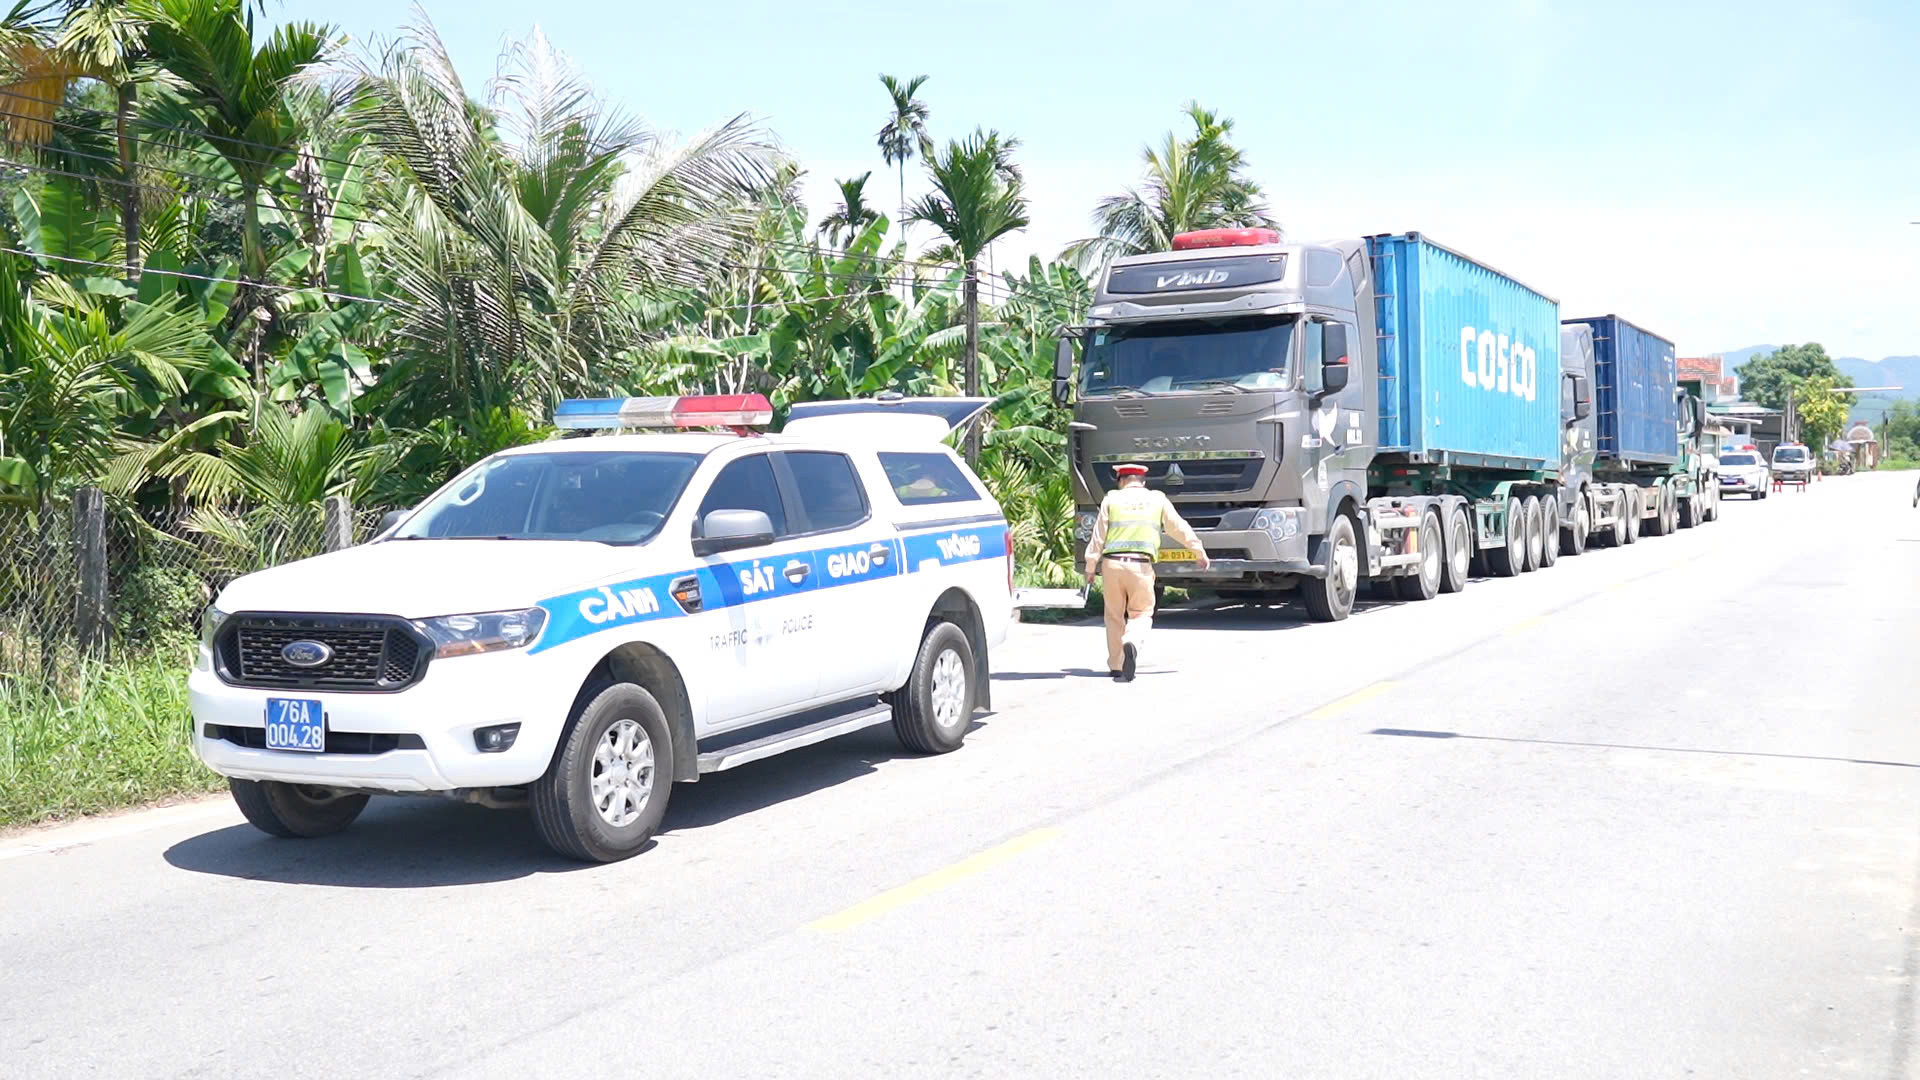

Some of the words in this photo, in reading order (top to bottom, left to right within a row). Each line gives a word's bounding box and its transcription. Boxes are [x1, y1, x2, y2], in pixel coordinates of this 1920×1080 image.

[1460, 325, 1537, 402] COSCO
[740, 560, 775, 595] SÁT
[827, 551, 870, 578] GIAO
[710, 629, 748, 651] TRAFFIC
[782, 614, 813, 635] POLICE
[289, 646, 315, 661] Ford
[279, 700, 310, 723] 76A
[269, 723, 322, 748] 004.28
